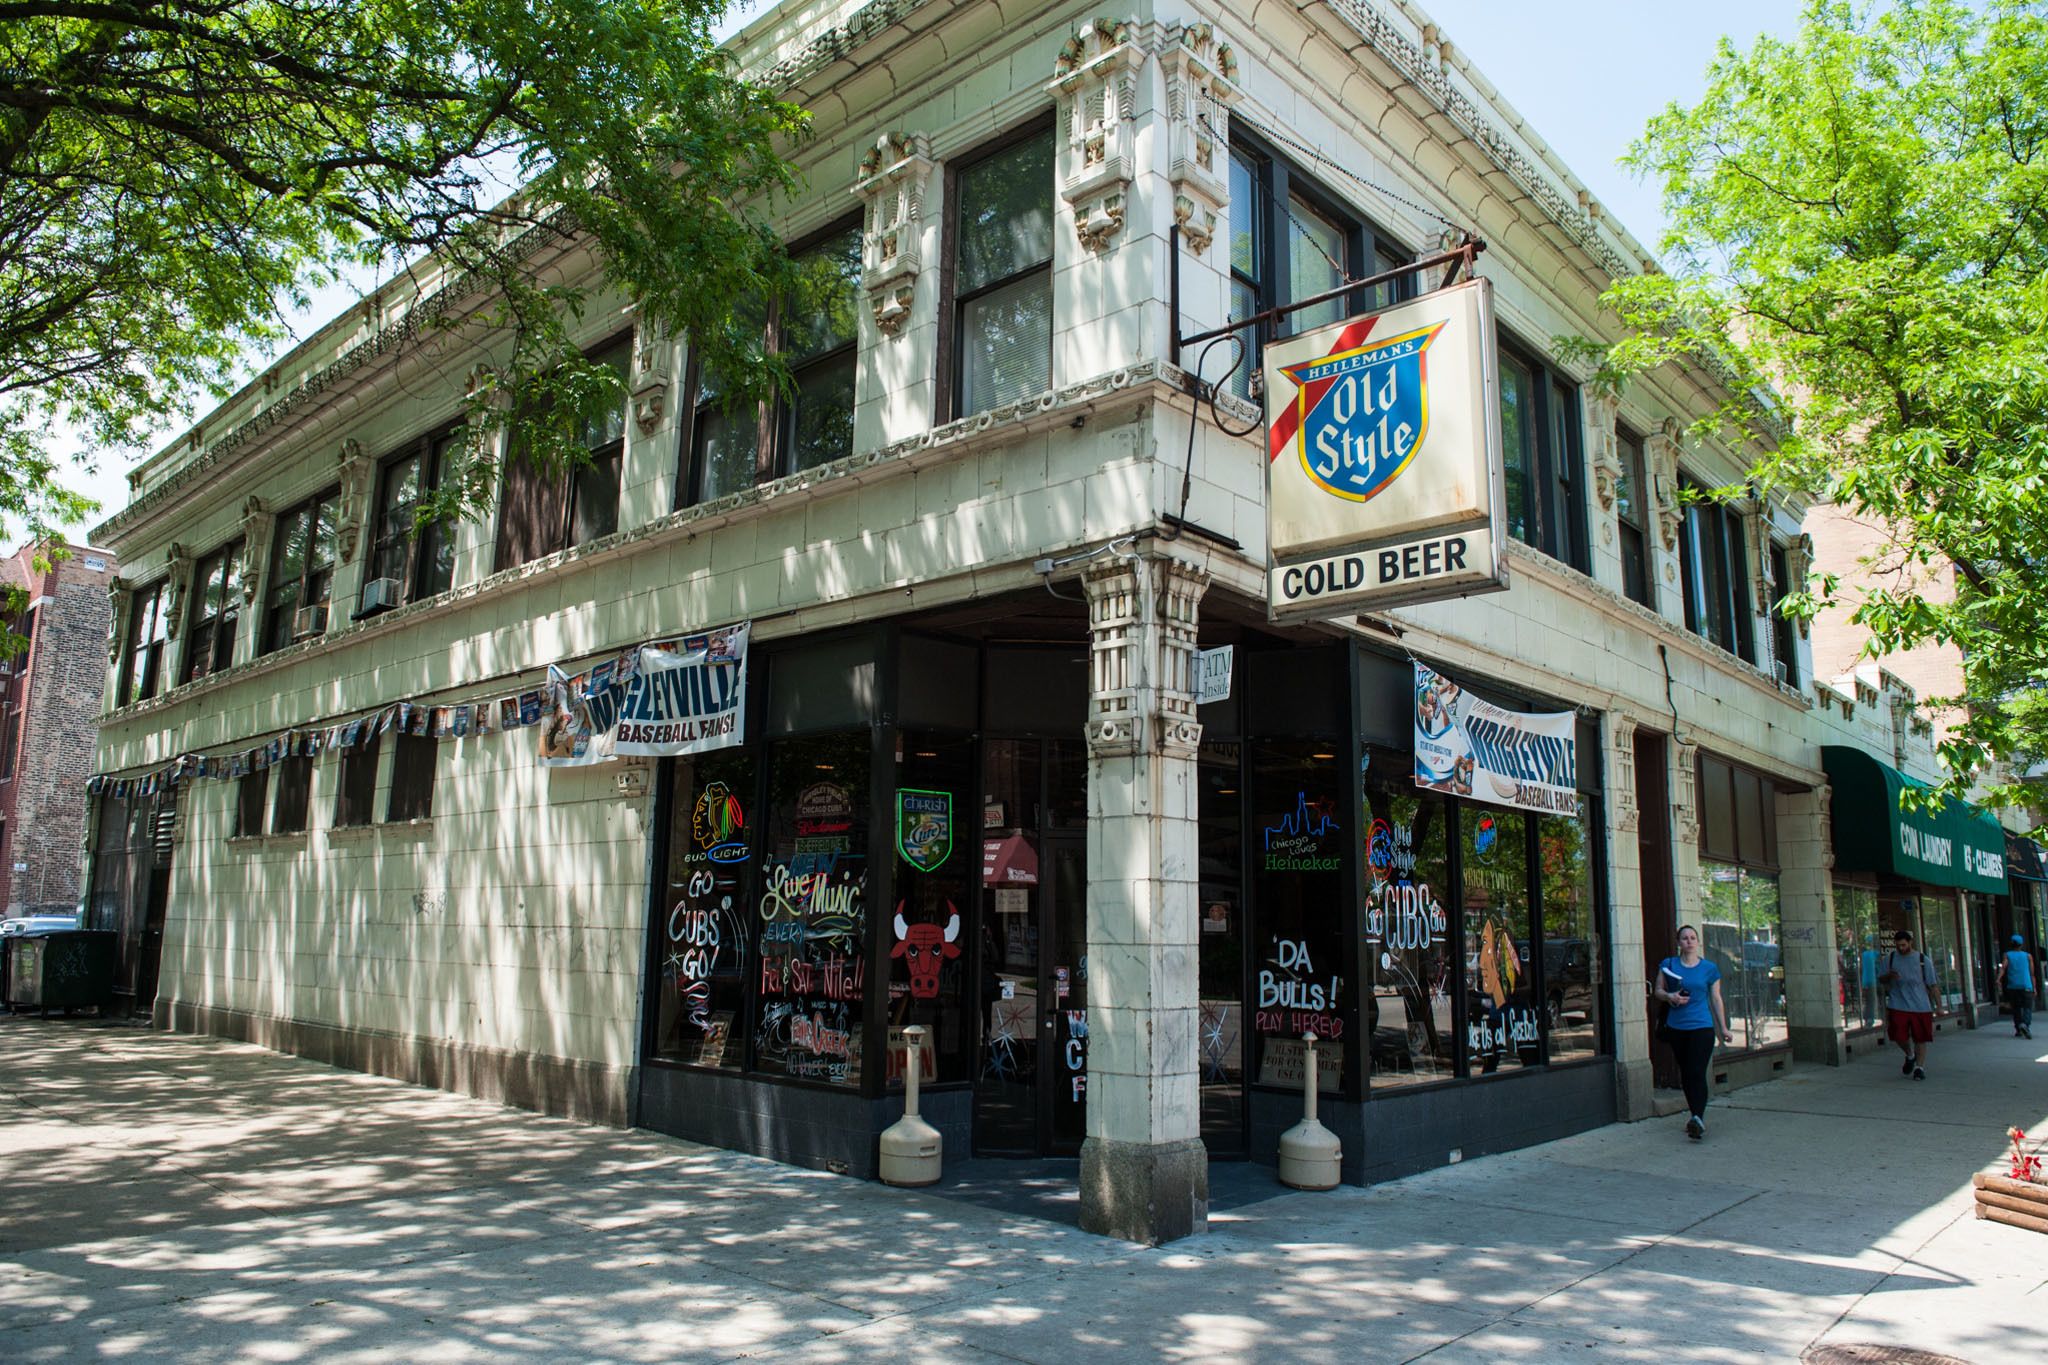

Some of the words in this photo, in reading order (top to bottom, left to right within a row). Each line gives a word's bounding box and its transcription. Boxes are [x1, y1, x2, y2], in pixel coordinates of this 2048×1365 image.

[1308, 340, 1414, 379] HEILEMAN'S
[1333, 363, 1398, 425] Old
[1316, 414, 1413, 486] Style
[1282, 557, 1365, 600] COLD
[1378, 537, 1467, 584] BEER
[1204, 651, 1232, 678] ATM
[1204, 679, 1230, 699] Inside
[616, 722, 698, 745] BASEBALL
[699, 712, 736, 740] FANS!
[1514, 783, 1554, 810] BASEBALL
[1271, 836, 1309, 850] Chicago
[1393, 821, 1412, 847] Old
[1900, 821, 1919, 859] COIN
[1919, 831, 1952, 867] LAUNDRY
[685, 852, 707, 863] BUD
[713, 847, 749, 859] LIGHT
[1289, 843, 1318, 856] Loves
[1390, 841, 1417, 879] Style
[1976, 849, 2003, 879] CLEANERS
[688, 870, 714, 898] GO
[760, 864, 811, 920] Live
[809, 870, 861, 918] Music
[668, 900, 720, 947] CUBS
[1384, 883, 1430, 950] CUBS
[682, 945, 720, 980] GO!
[1258, 968, 1338, 1012] BULLS!
[1255, 1010, 1283, 1032] PLAY
[1292, 1010, 1330, 1036] HERE
[886, 1049, 933, 1078] OPN
[1275, 1044, 1331, 1057] RESTRMS
[1287, 1058, 1337, 1072] CUSMER
